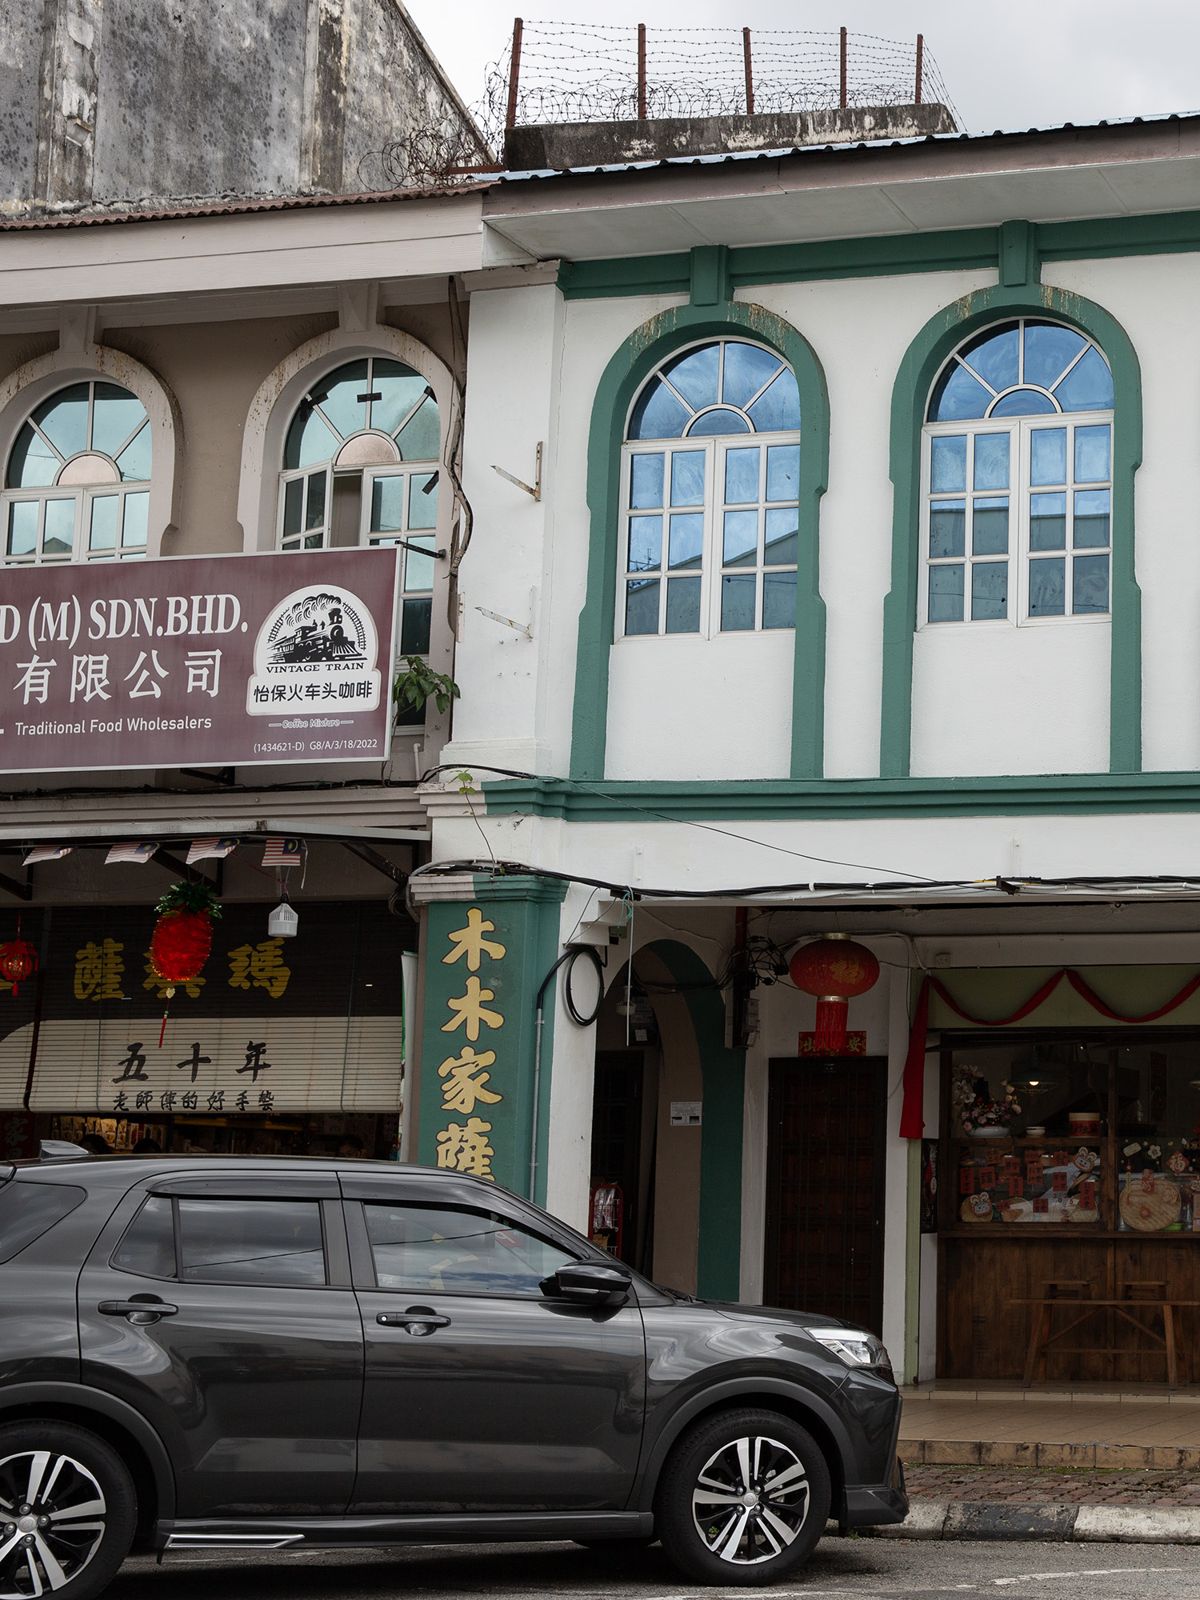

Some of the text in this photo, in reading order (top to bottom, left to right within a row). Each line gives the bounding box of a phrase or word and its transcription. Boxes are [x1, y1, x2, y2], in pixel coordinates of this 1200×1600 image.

[28, 594, 82, 651] (M)
[88, 593, 249, 641] SDN.BHD.
[13, 648, 223, 705] 有限公司
[266, 662, 365, 674] VINTAGE TRAIN
[253, 680, 373, 703] 怡保火车头咖啡
[15, 715, 213, 736] Traditional Food Wholesalers
[282, 719, 309, 729] Coffee
[253, 738, 378, 753] (1434621-D) G8/A/3/18/2022
[73, 936, 292, 1002] 薩瑪
[112, 1040, 272, 1083] 五十年
